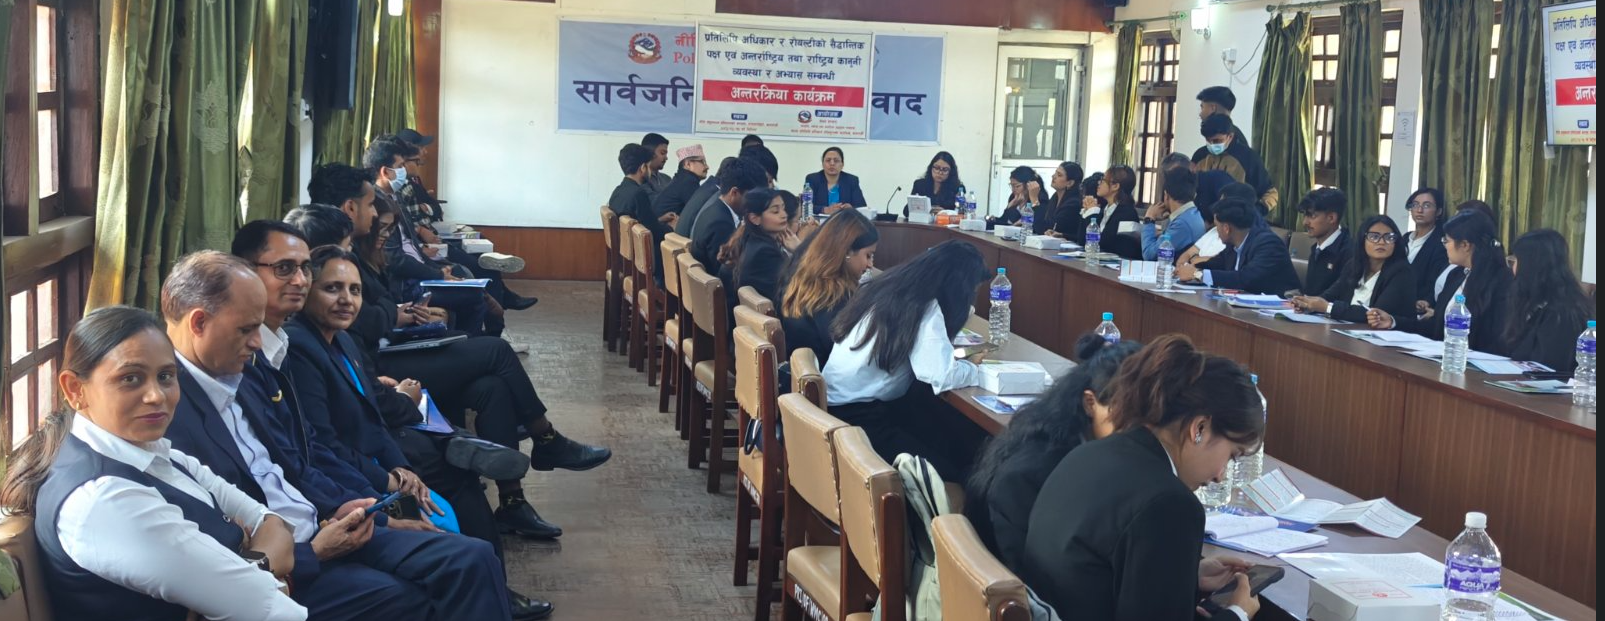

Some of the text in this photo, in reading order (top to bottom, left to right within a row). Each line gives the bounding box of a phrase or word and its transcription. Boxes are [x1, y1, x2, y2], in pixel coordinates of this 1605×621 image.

[704, 32, 738, 42] प्रतिलिपि
[742, 33, 775, 46] अधिकार
[779, 38, 785, 47] र
[706, 50, 721, 59] पक्ष
[788, 54, 803, 63] तथा
[732, 67, 836, 81] व्यवस्था र अभ्यास सम्बन्धी
[573, 73, 927, 115] सार्वजनि वाद
[730, 84, 836, 104] अन्तरक्रिया कार्यक्रम
